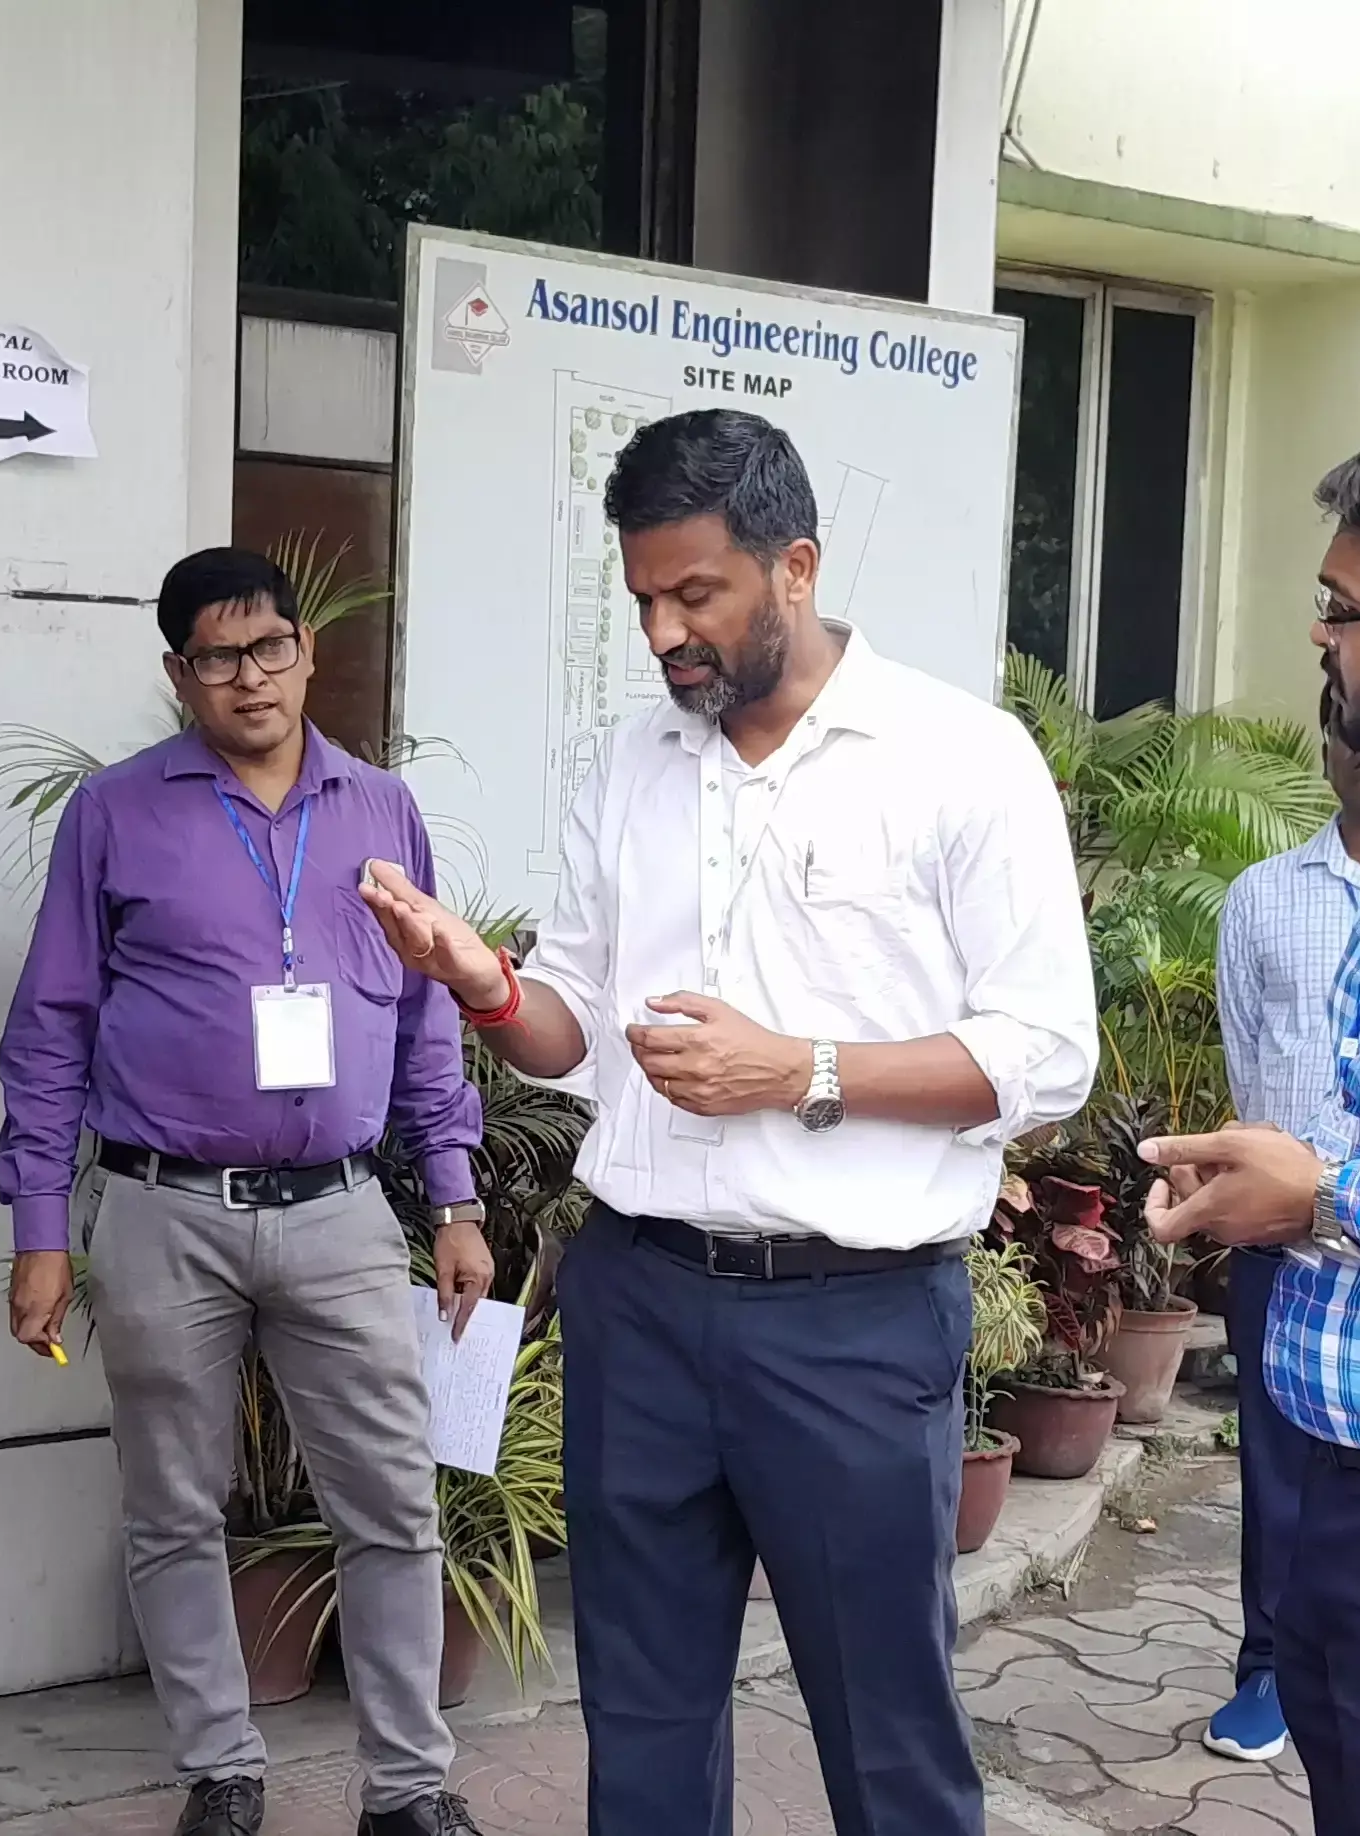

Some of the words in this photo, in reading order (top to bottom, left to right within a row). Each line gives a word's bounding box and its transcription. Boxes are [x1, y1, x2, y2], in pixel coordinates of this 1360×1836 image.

[525, 278, 660, 336] Asansol
[671, 299, 859, 375] Engineering
[869, 330, 978, 389] College
[2, 362, 69, 385] ROOM
[683, 365, 735, 392] SITE
[743, 373, 793, 398] MAP
